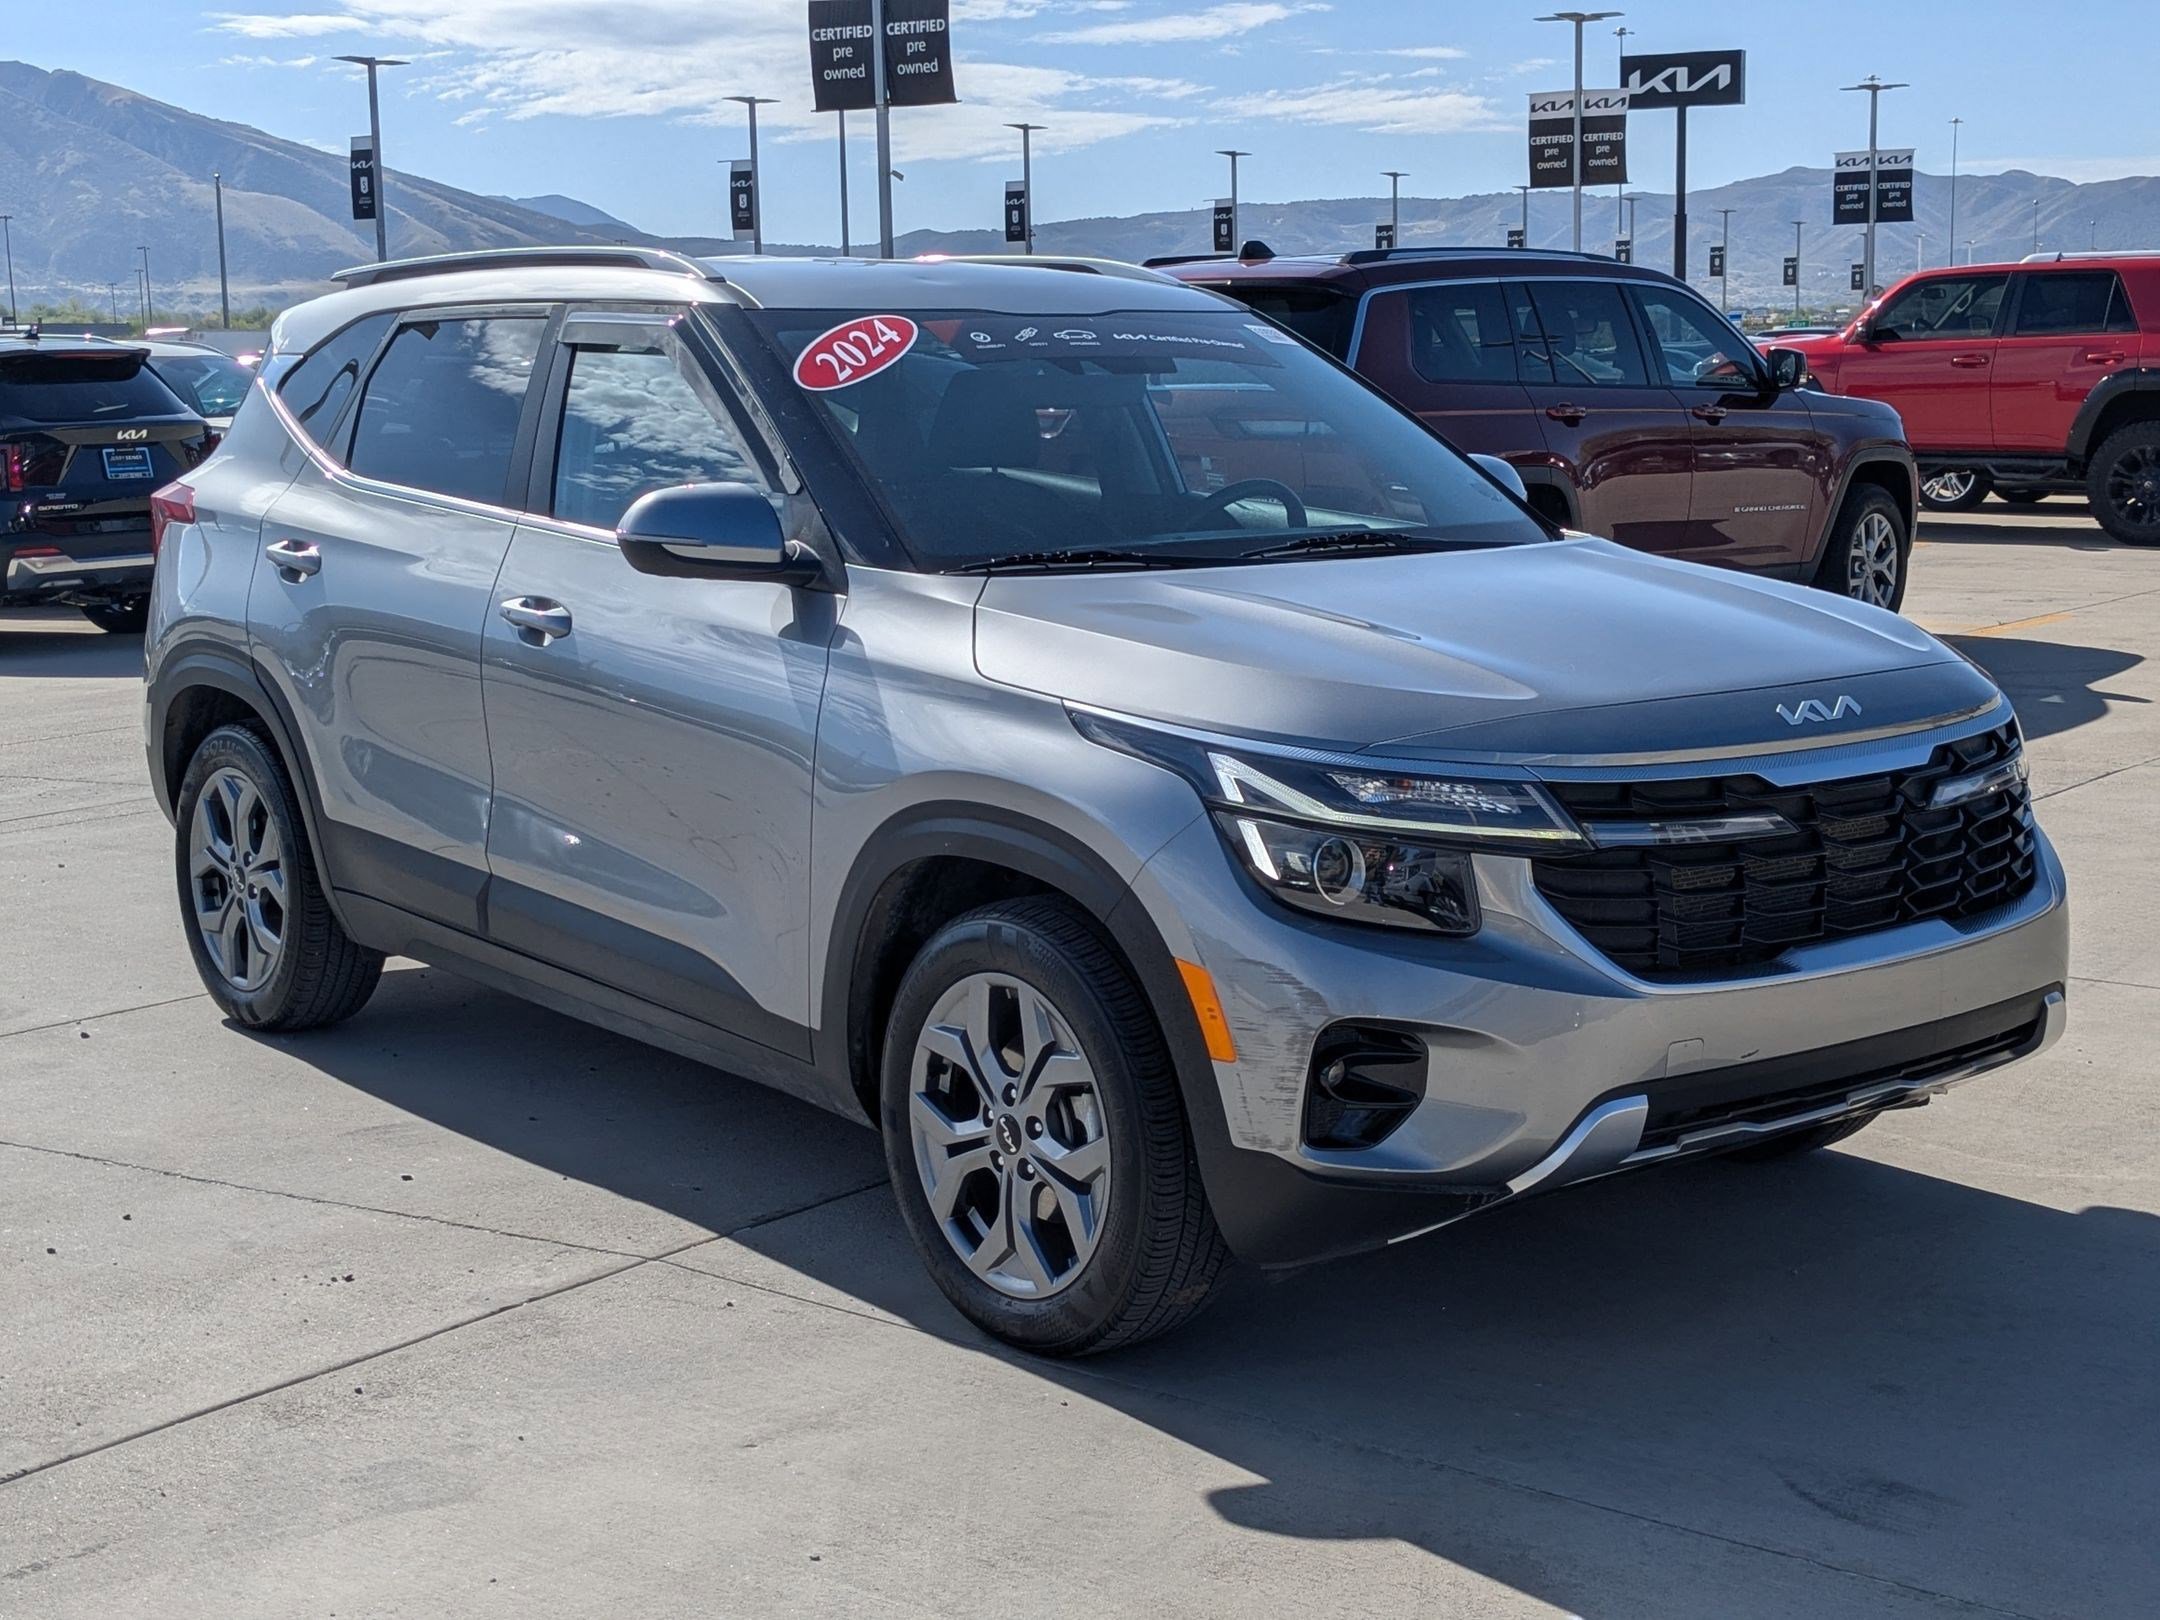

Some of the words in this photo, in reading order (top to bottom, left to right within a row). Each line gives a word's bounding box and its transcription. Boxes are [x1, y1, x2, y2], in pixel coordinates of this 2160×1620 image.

[811, 25, 873, 42] CERTIFIED
[886, 18, 946, 36] CERTIFIED
[832, 46, 854, 61] pre
[906, 41, 927, 56] pre
[823, 63, 866, 81] owned
[896, 58, 939, 76] owned
[1628, 63, 1732, 95] KIA
[1530, 99, 1574, 113] KIA
[1583, 96, 1627, 110] KIA
[1530, 134, 1574, 146] CERTIFIED
[1582, 131, 1624, 142] CERTIFIED
[1544, 147, 1559, 158] pre
[1595, 144, 1610, 156] pre
[1536, 158, 1567, 170] owned
[1588, 156, 1618, 168] owned
[1836, 156, 1870, 167] KIA
[1878, 154, 1913, 165] KIA
[1835, 183, 1870, 192] CERTIFIED
[1877, 181, 1911, 190] CERTIFIED
[815, 319, 902, 382] 2024
[117, 429, 148, 440] KIA
[1775, 695, 1862, 725] KIA
[999, 1117, 1017, 1153] KIA
